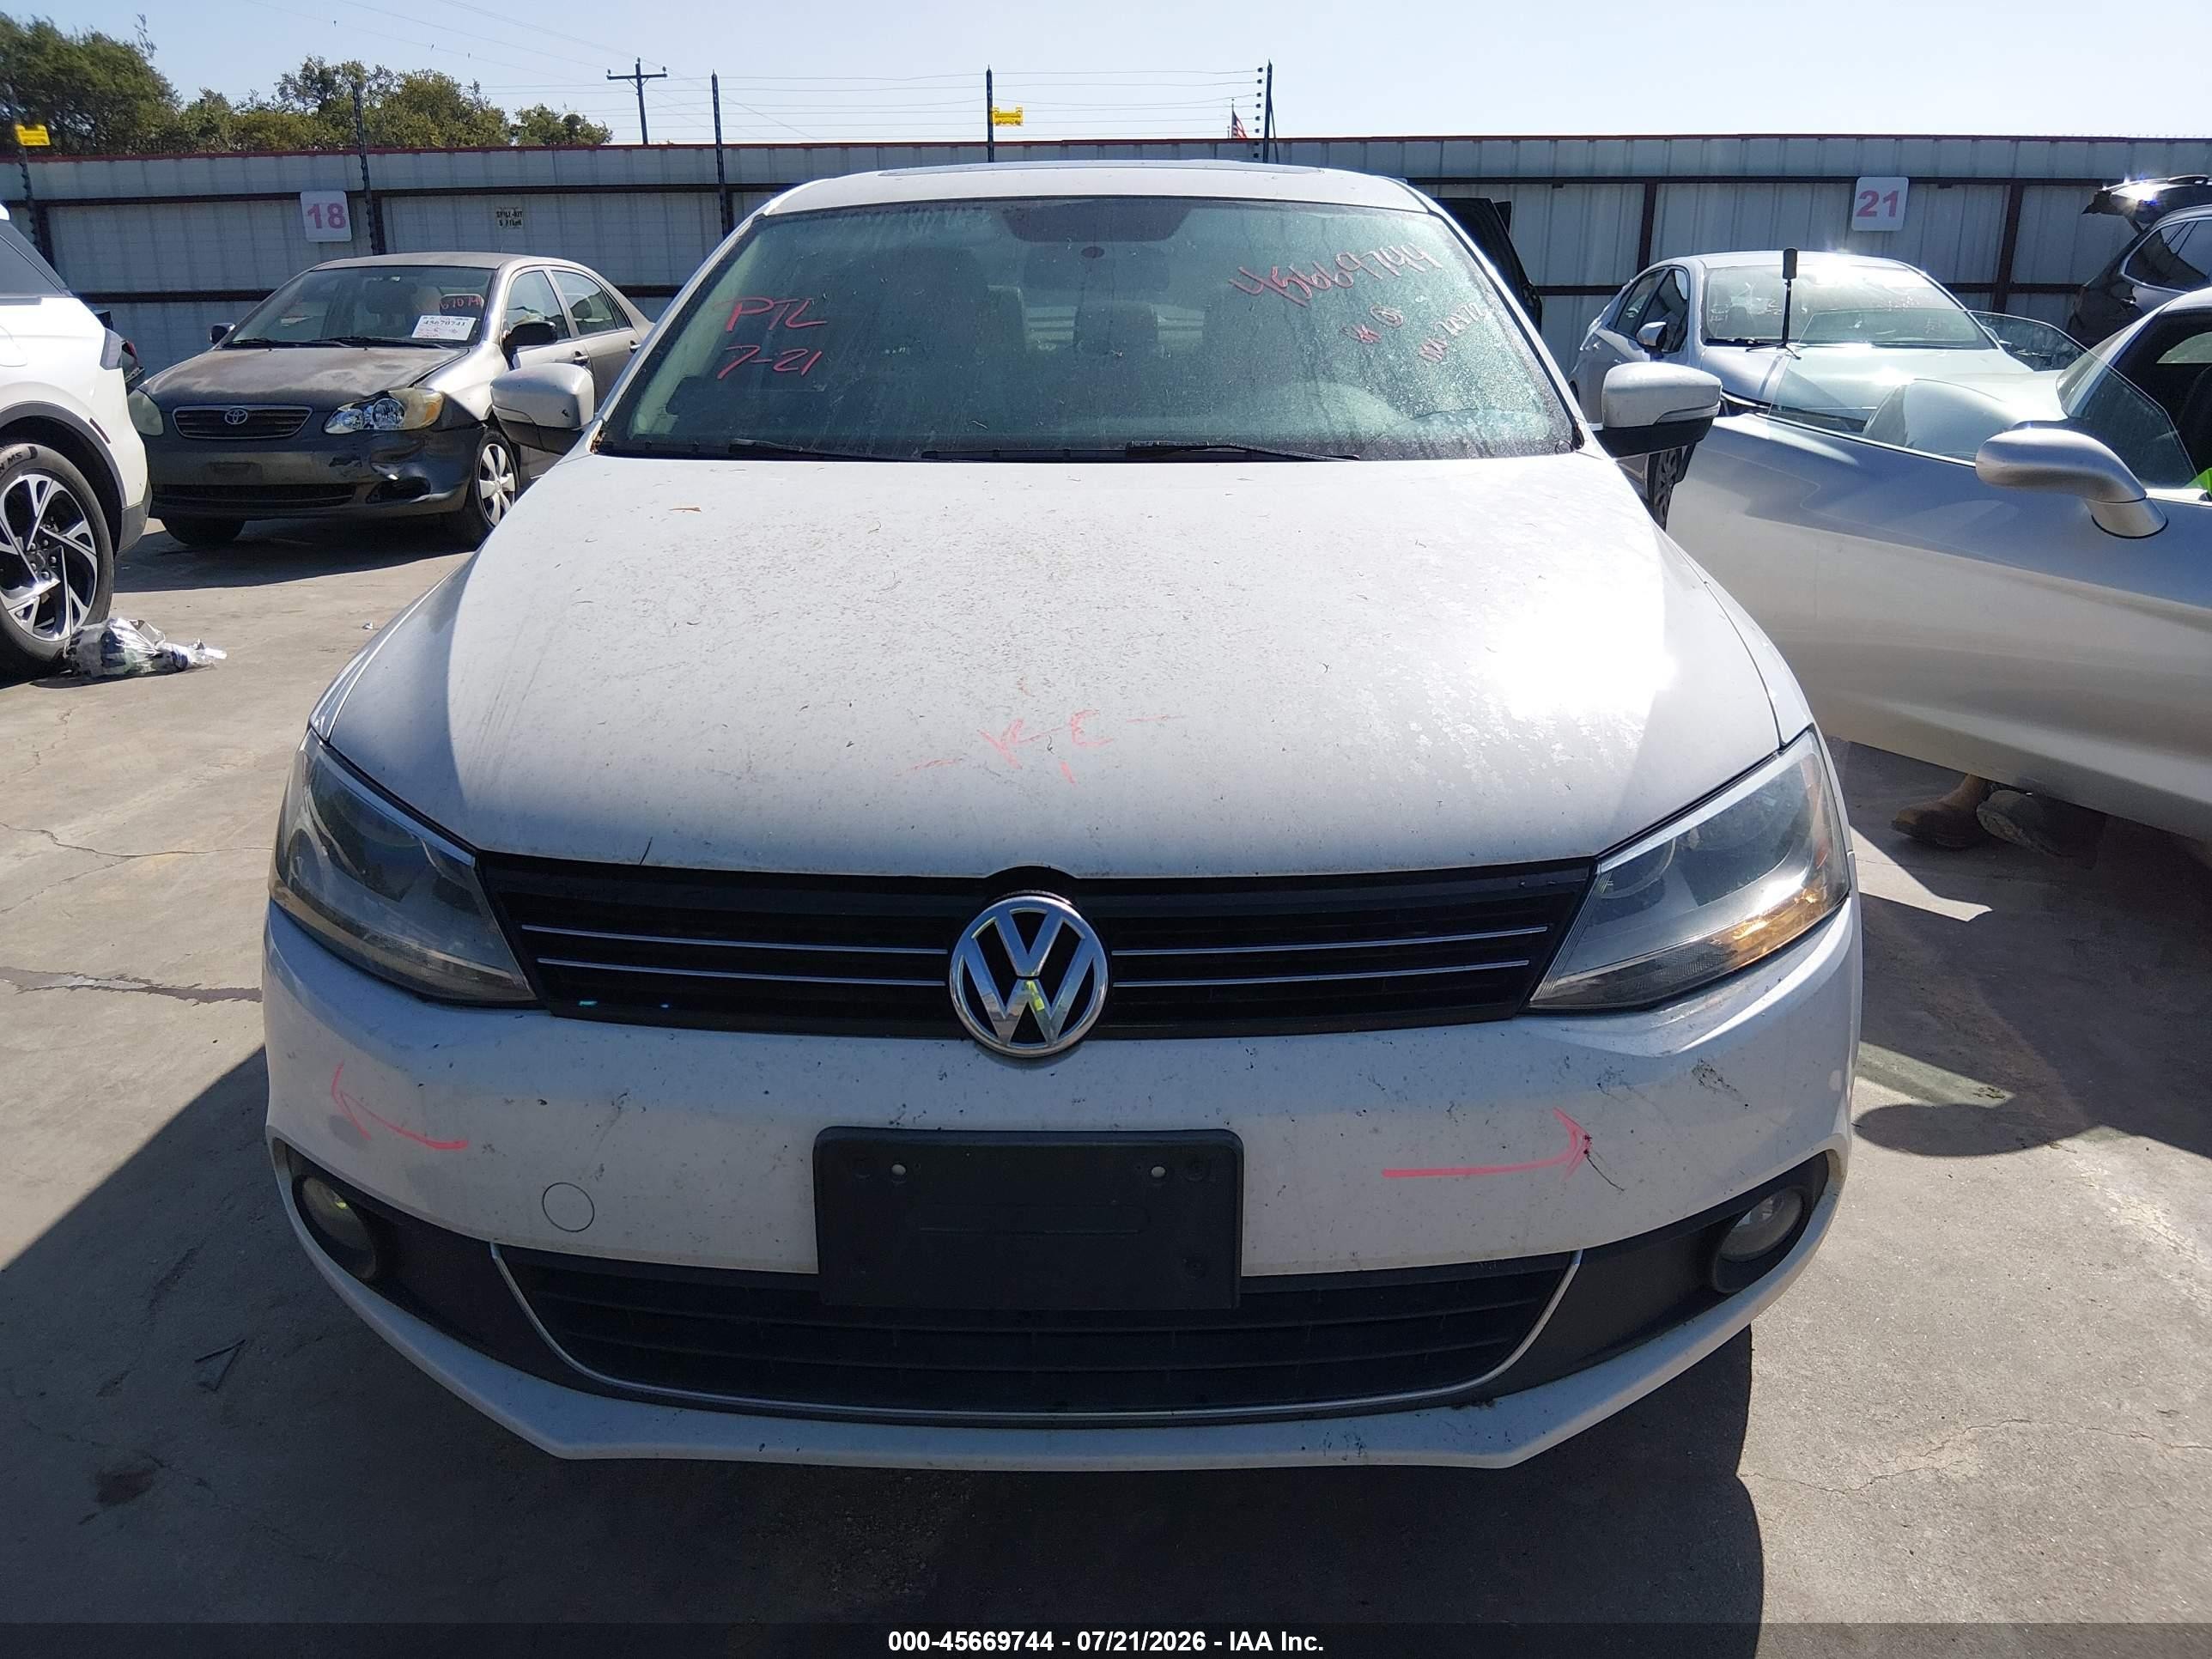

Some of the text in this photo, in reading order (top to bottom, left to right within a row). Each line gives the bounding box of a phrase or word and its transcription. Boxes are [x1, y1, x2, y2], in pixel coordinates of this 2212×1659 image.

[307, 203, 346, 229] 18
[1856, 190, 1899, 217] 21
[1229, 242, 1443, 308] 45669744
[715, 296, 828, 331] PTL
[717, 344, 823, 380] 7-21
[949, 895, 1109, 1058] VW
